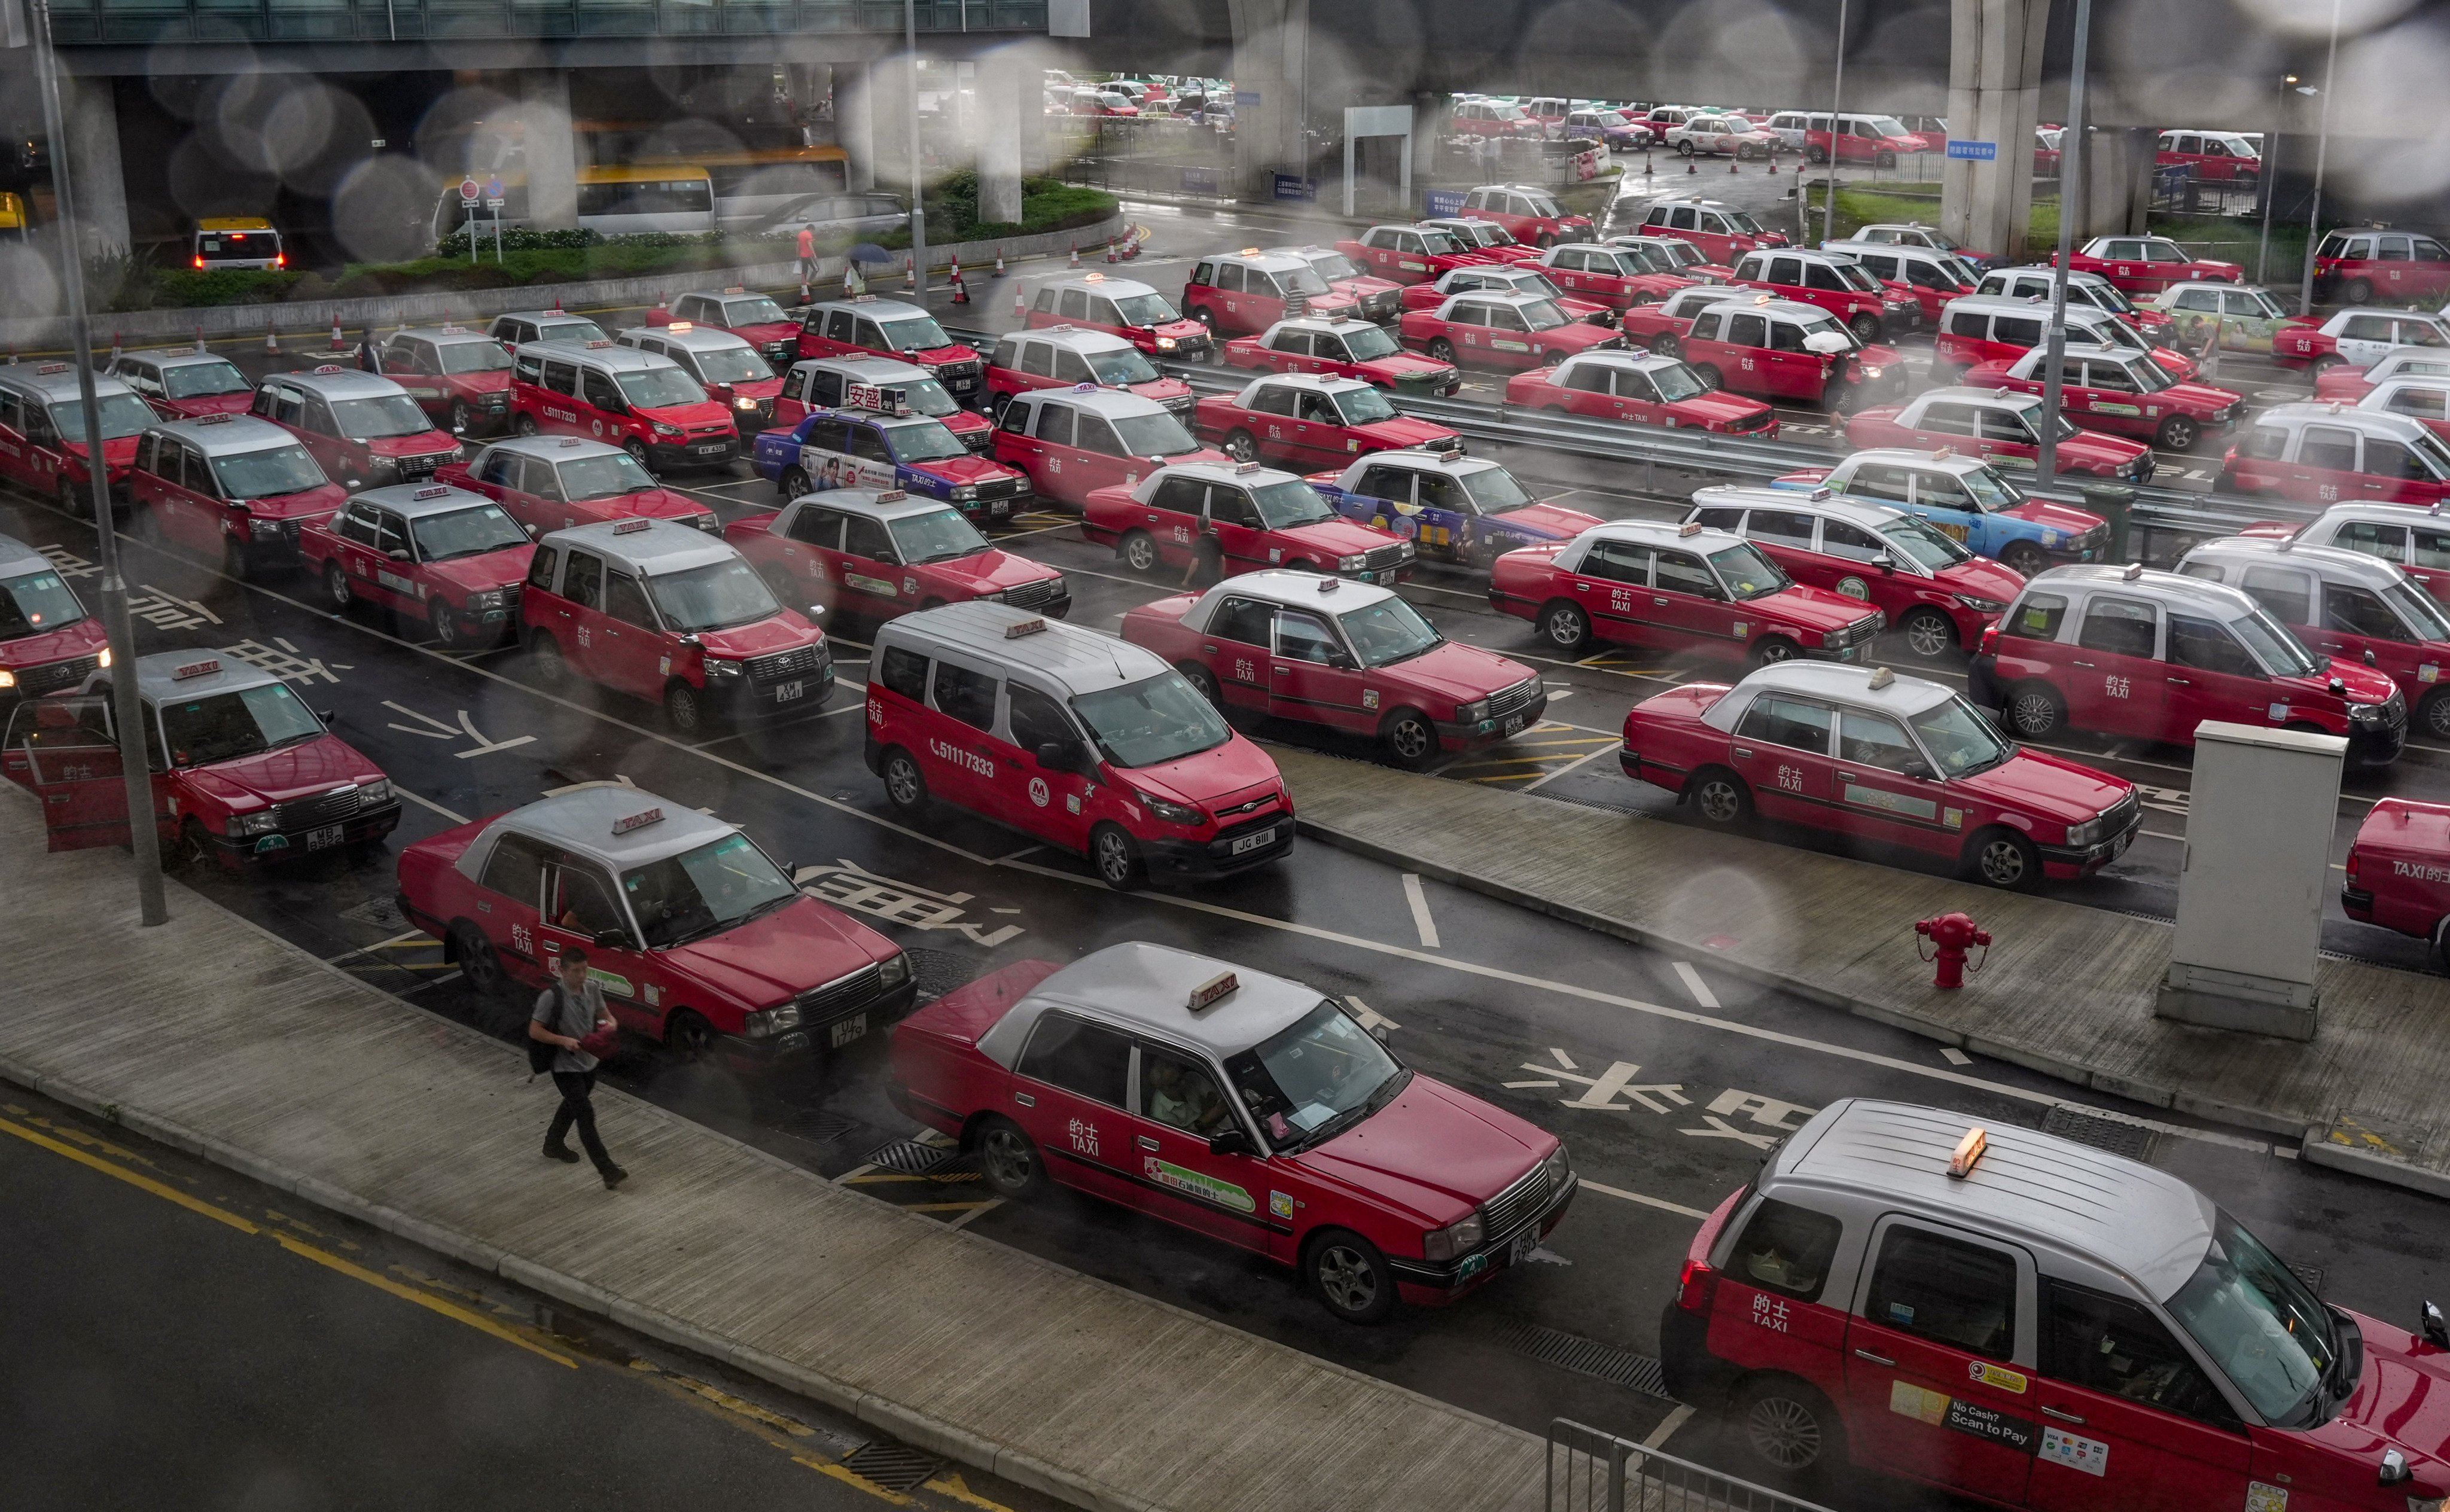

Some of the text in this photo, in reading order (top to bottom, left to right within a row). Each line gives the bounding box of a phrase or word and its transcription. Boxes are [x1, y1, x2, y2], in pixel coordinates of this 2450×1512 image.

[850, 386, 879, 409] 安盛
[881, 400, 893, 410] AXA
[205, 413, 228, 422] TAXI
[1635, 413, 1648, 422] TAXI
[1049, 458, 1061, 467] 的士
[912, 474, 936, 487] TAXI 的士
[420, 486, 447, 497] TAXI
[2320, 484, 2338, 493] 的士
[884, 490, 904, 500] TAXI
[620, 521, 648, 532] TAXI
[1174, 526, 1189, 534] 的士
[1687, 524, 1701, 534] TAXI
[1175, 534, 1189, 543] TAXI
[810, 559, 823, 569] 的士
[810, 569, 824, 579] TAXI
[1612, 588, 1631, 600] 的士
[1611, 600, 1630, 612] TAXI
[578, 625, 589, 636] 的士
[1014, 620, 1040, 633] TAXI
[578, 635, 590, 647] TAXI
[180, 660, 218, 676] TAXI
[1236, 658, 1253, 669] 的士
[1236, 669, 1254, 682] TAXI
[2107, 676, 2129, 687] 的士
[784, 682, 796, 691] XM
[2107, 686, 2129, 699] TAXI
[779, 691, 800, 702] 4341
[869, 698, 882, 711] 的士
[870, 711, 882, 725] TAXI
[1510, 718, 1517, 727] LE
[1505, 726, 1522, 737] 9908
[940, 740, 994, 779] 5111 7333
[1779, 765, 1802, 777] 的士
[1779, 776, 1802, 791] TAXI
[624, 809, 660, 828] TAXI
[317, 828, 334, 840] MB
[310, 834, 342, 850] 8922
[1240, 833, 1269, 850] JG 8111
[2394, 861, 2424, 880] TAXI
[513, 924, 532, 938] 的士
[514, 938, 534, 955] TAXI
[1201, 972, 1235, 1002] TAXI
[840, 1018, 855, 1030] UZ
[835, 1026, 863, 1043] 1779
[1069, 1118, 1099, 1138] 的士
[1070, 1133, 1099, 1157] TAXI
[1952, 1157, 1961, 1173] 的士
[1162, 1173, 1219, 1200] 豐田石油氣的士
[1519, 1233, 1532, 1245] HM
[1515, 1240, 1536, 1262] 2913
[1753, 1292, 1790, 1319] 的士
[1753, 1312, 1787, 1333] TAXI
[1952, 1401, 2000, 1422] No Cash?
[1952, 1412, 1985, 1430] Scan
[1986, 1421, 2000, 1434] to
[2003, 1426, 2028, 1445] Pay
